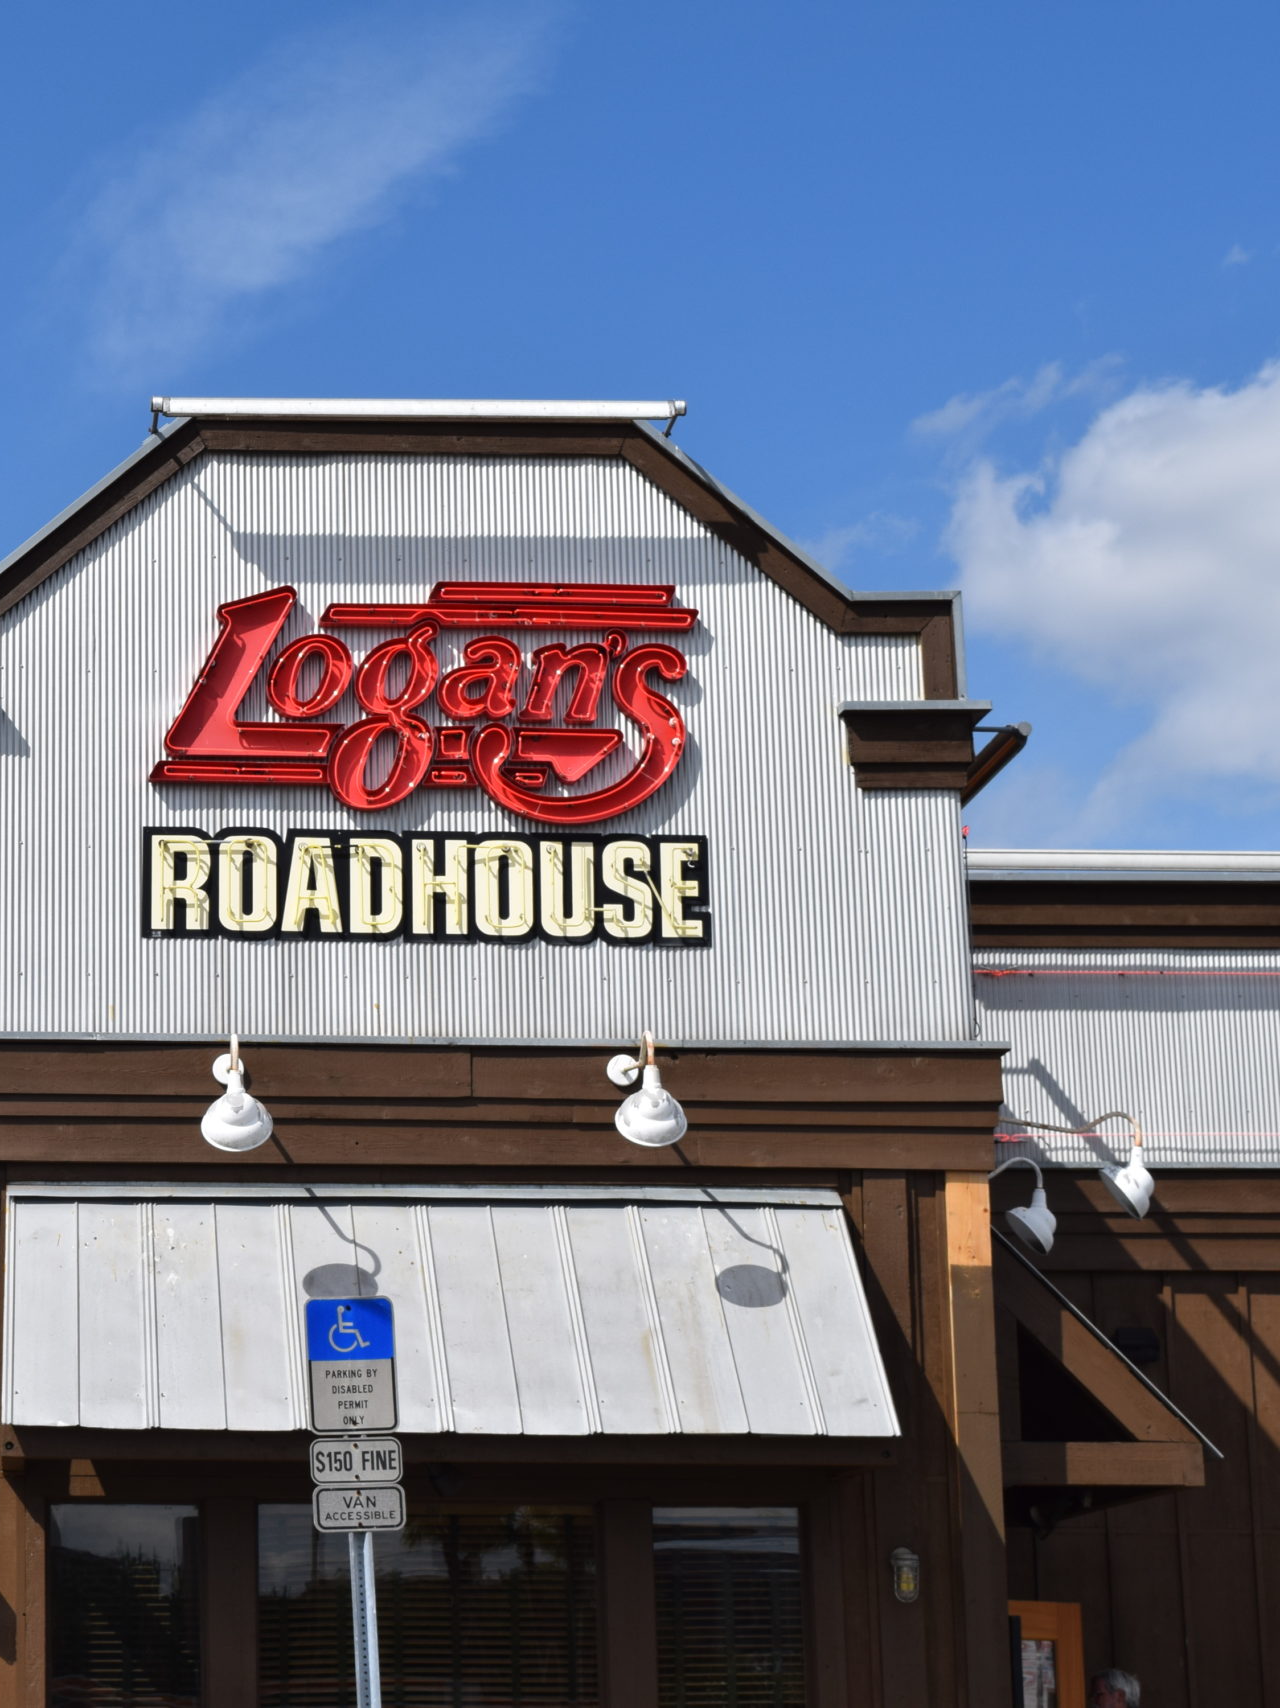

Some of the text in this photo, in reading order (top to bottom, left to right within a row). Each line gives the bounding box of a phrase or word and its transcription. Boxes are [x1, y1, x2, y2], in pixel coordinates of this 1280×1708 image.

[158, 583, 692, 824] Logan's
[147, 830, 705, 942] ROADHOUSE
[325, 1368, 378, 1379] PARKING BY
[331, 1384, 374, 1395] DISABLED
[337, 1400, 369, 1410] PERMIT
[342, 1415, 365, 1426] ONLY
[315, 1450, 397, 1474] $150 FINE
[342, 1495, 377, 1509] VAN
[324, 1510, 397, 1521] ACCESSIBLE
